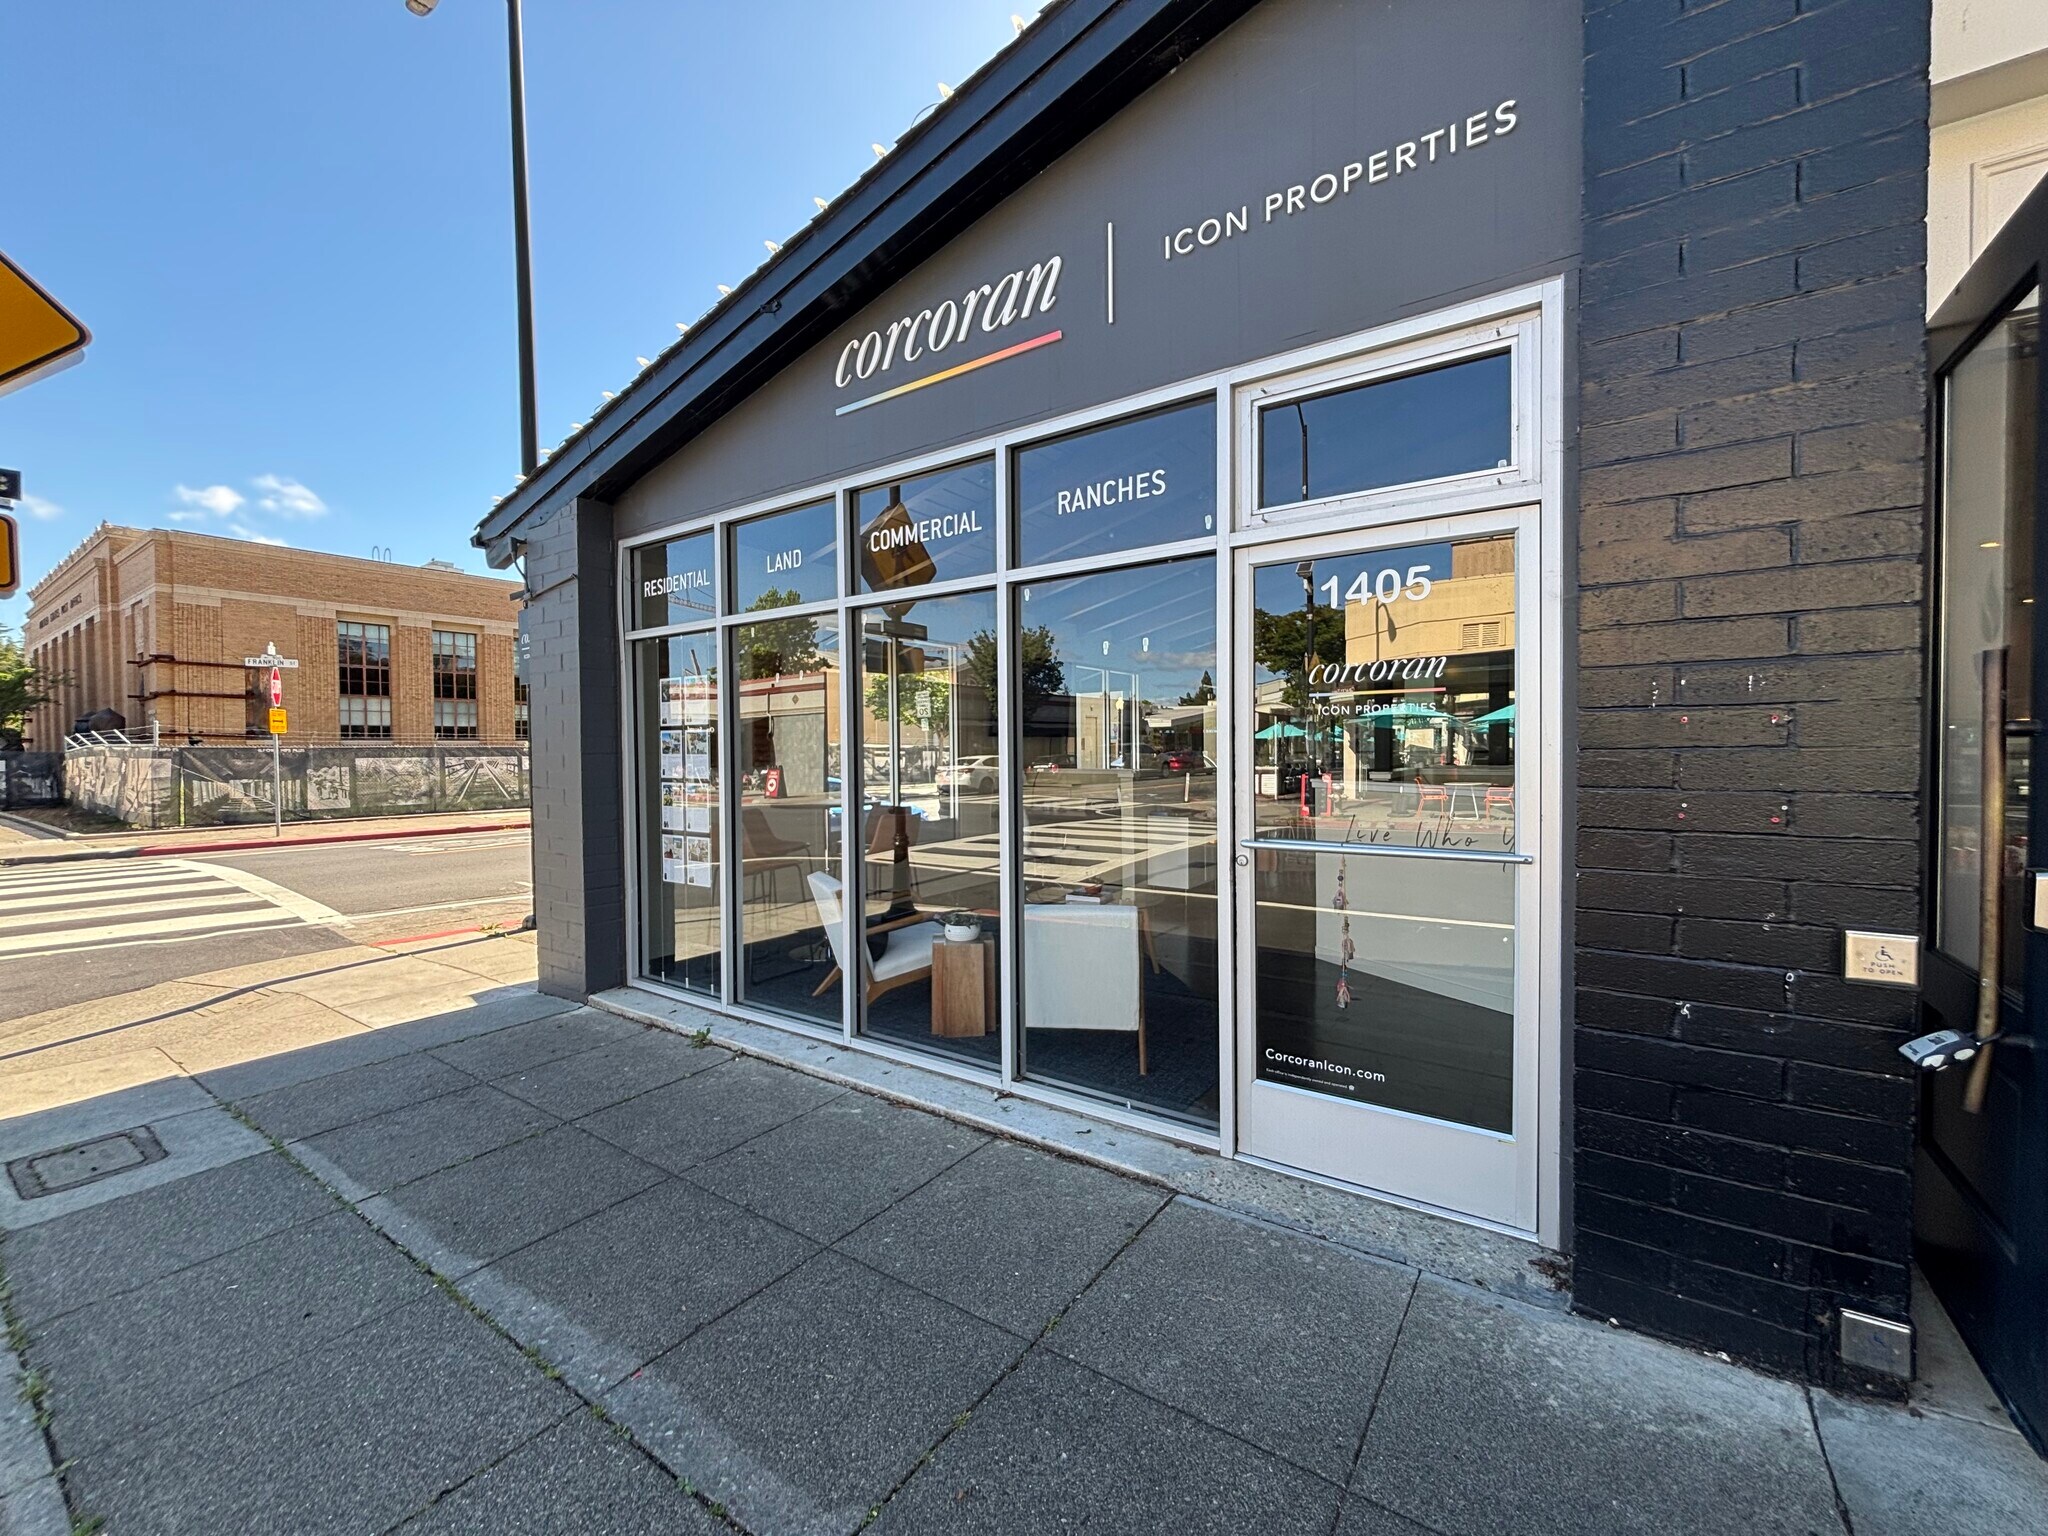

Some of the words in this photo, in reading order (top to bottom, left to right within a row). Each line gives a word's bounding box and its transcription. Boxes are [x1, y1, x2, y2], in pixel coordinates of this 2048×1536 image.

[834, 254, 1064, 389] corcoran
[1164, 205, 1248, 260] ICON
[1264, 98, 1519, 223] PROPERTIES
[1057, 468, 1167, 516] RANCHES
[869, 510, 983, 553] COMMERCIAL
[766, 549, 802, 574] LAND
[643, 568, 711, 598] RESIDENTIAL
[1320, 564, 1433, 610] 1405
[247, 658, 285, 667] FRANKLIN
[1308, 655, 1448, 685] corcoran
[1318, 703, 1350, 716] ICON
[1355, 702, 1437, 715] PROPERTIES
[1345, 813, 1393, 844] Live
[1415, 813, 1479, 849] Who
[1862, 966, 1875, 974] TO
[1879, 968, 1904, 976] OPEN
[1870, 961, 1896, 969] PUSH
[1265, 1048, 1386, 1082] CorcoranIcon.com
